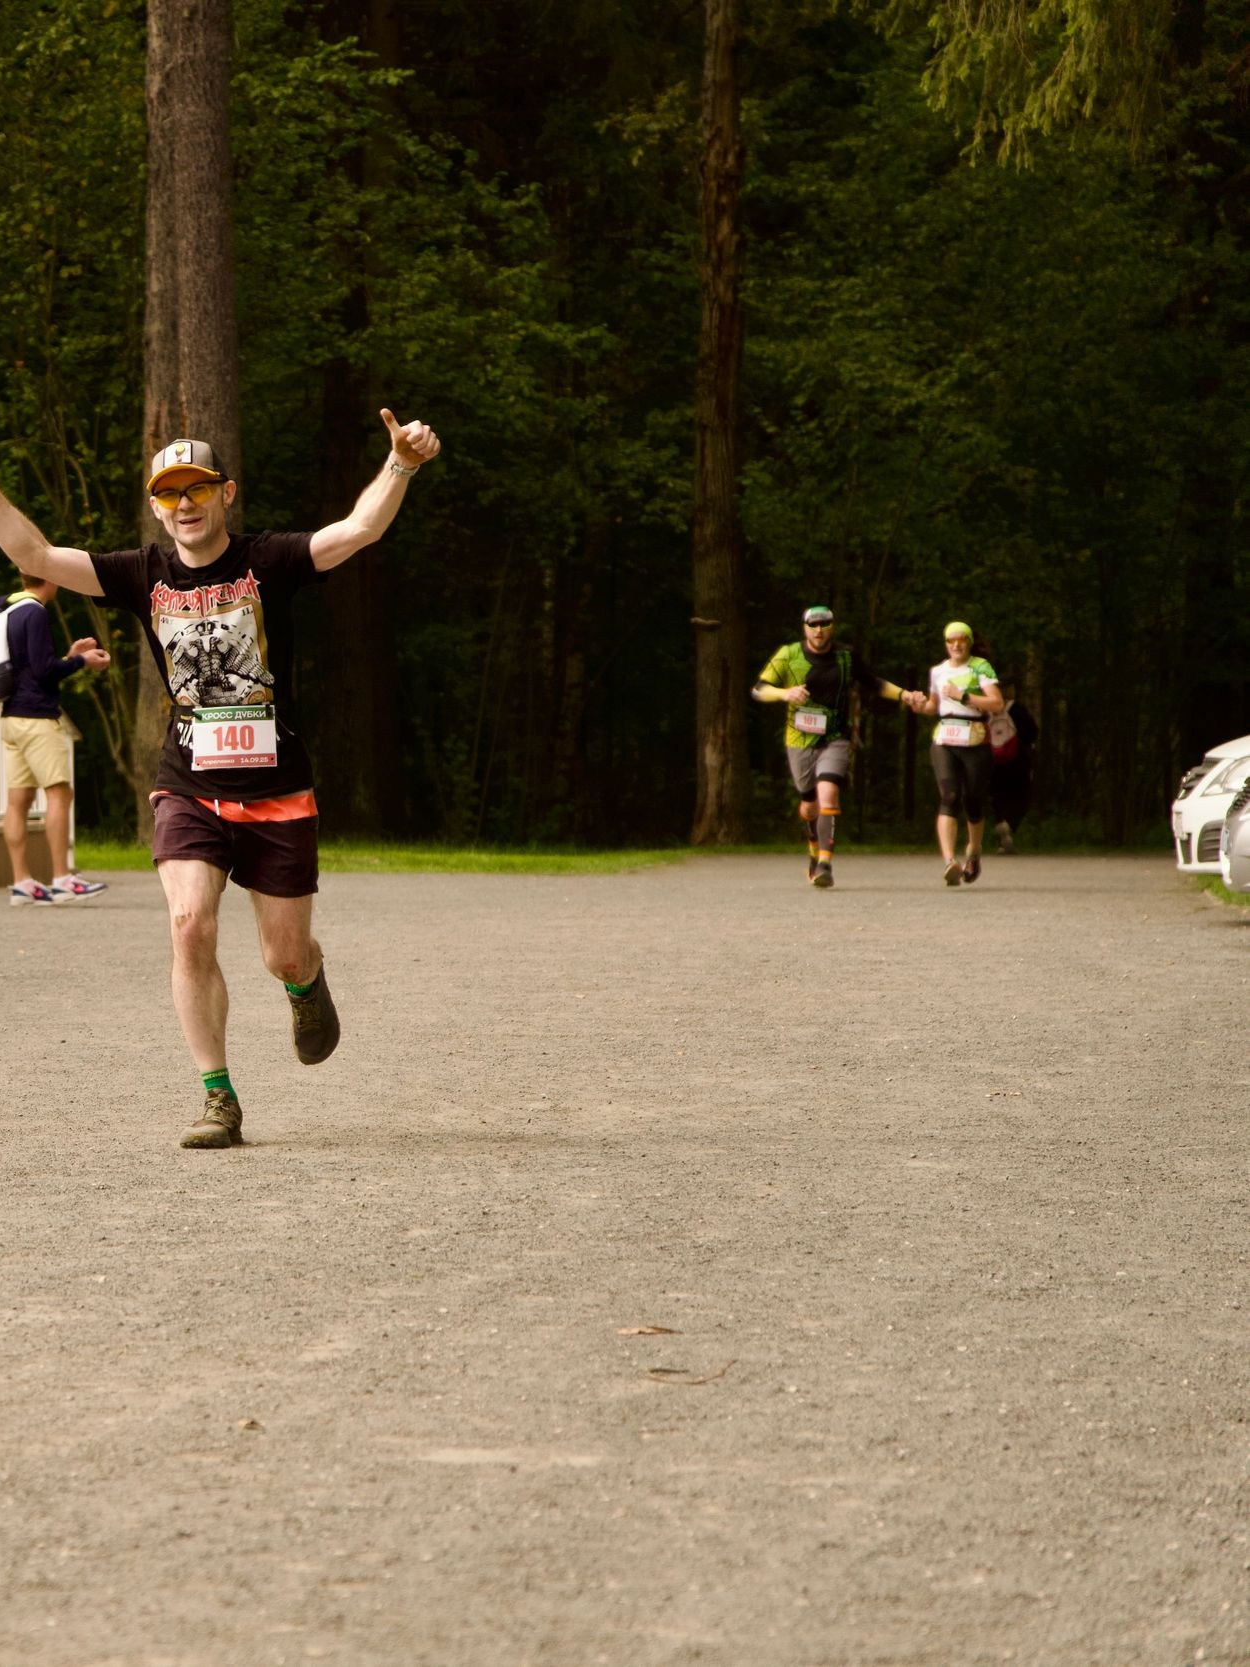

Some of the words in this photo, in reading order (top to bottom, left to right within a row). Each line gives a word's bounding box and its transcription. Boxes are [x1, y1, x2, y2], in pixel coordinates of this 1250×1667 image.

[202, 711, 233, 721] КРОСС
[235, 710, 267, 720] ДУБКИ
[213, 725, 255, 751] 140
